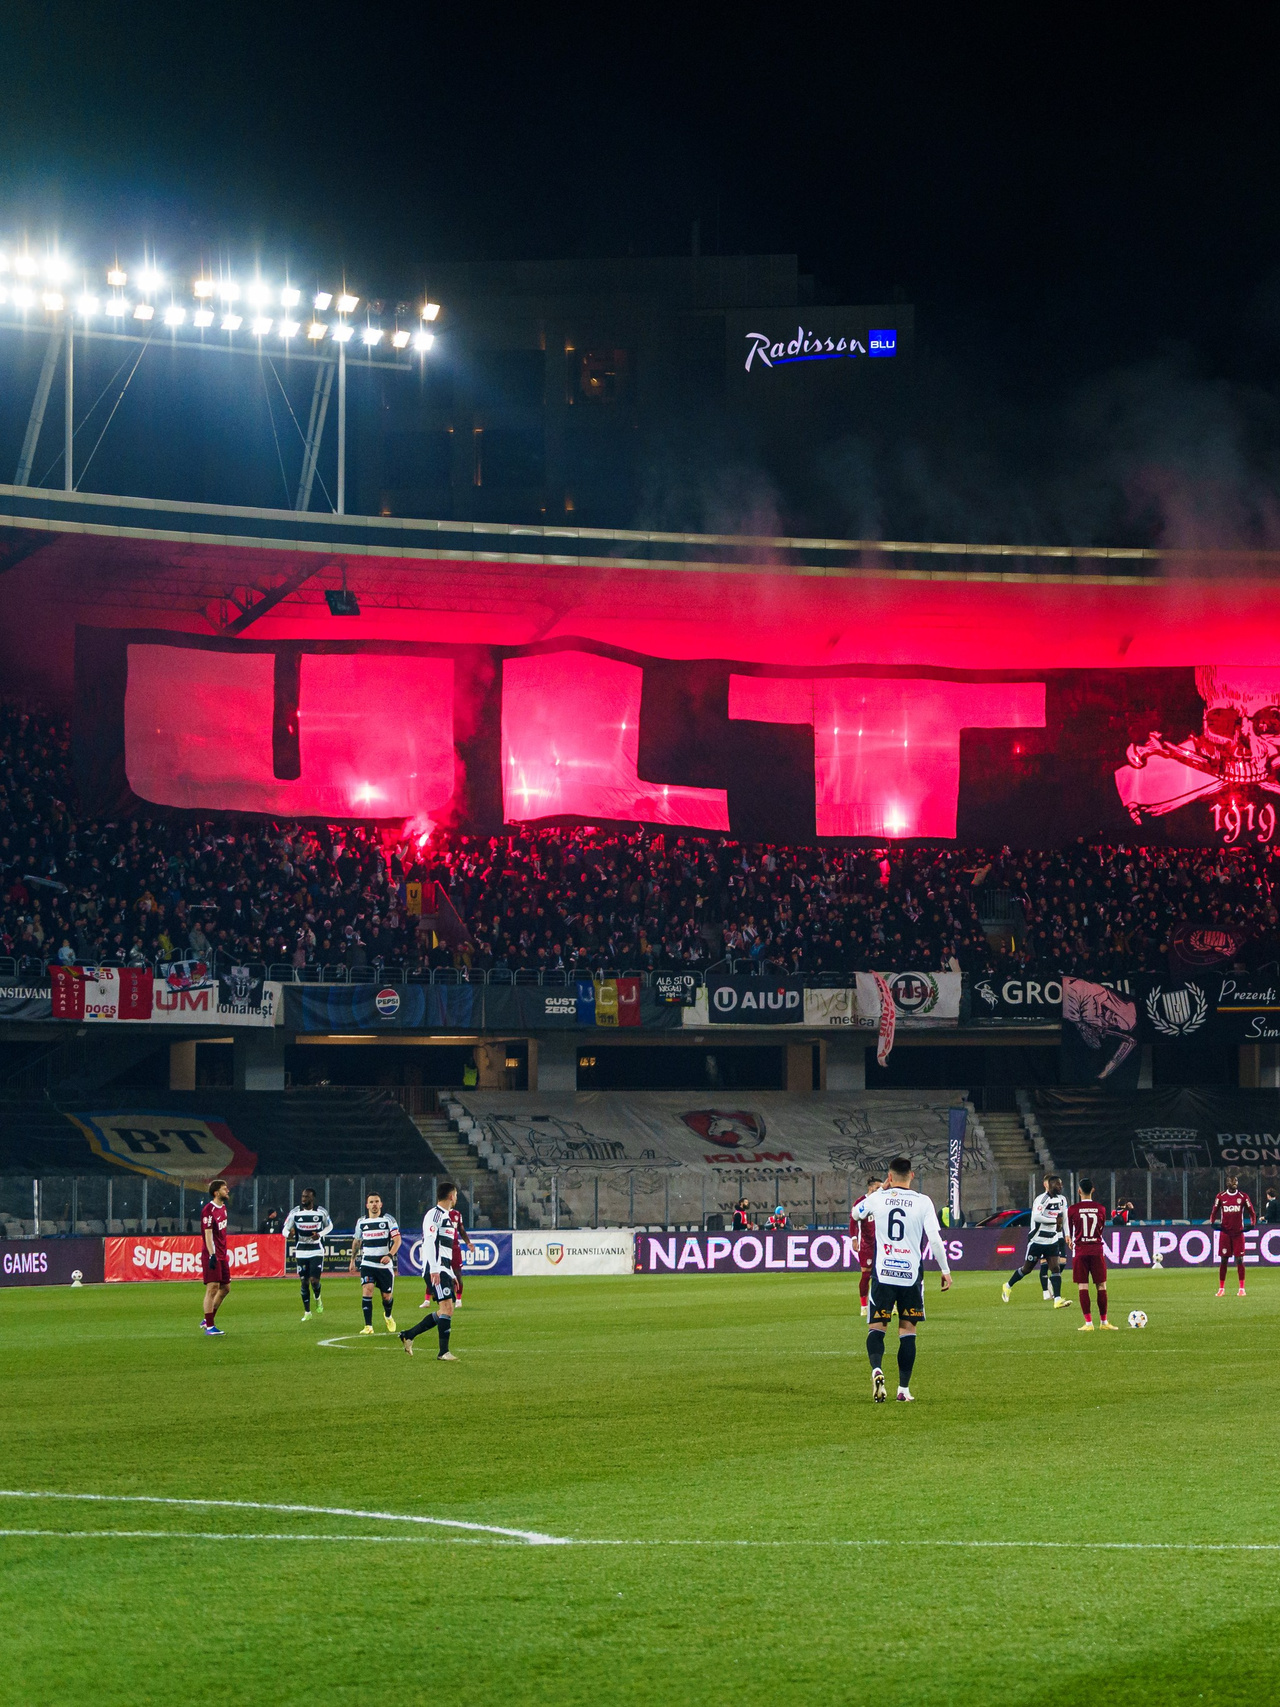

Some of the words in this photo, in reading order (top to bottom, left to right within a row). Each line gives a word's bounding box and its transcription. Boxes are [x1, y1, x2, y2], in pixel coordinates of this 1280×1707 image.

[744, 326, 866, 372] Radisson
[870, 339, 896, 349] BLU
[1210, 803, 1276, 843] 1919
[545, 997, 577, 1006] GUST
[741, 990, 800, 1010] AIUD
[85, 1005, 117, 1014] DOGS
[545, 1006, 577, 1014] ZERO
[829, 1015, 875, 1027] medica
[110, 1128, 208, 1154] BT
[703, 1152, 796, 1164] IRUM
[885, 1198, 913, 1208] CRISTEA
[887, 1207, 906, 1242] 6
[1079, 1213, 1099, 1237] 17
[515, 1248, 543, 1256] BANCA
[549, 1247, 561, 1256] BT
[566, 1246, 626, 1256] TRANSILVANIA
[3, 1252, 48, 1274] GAMES
